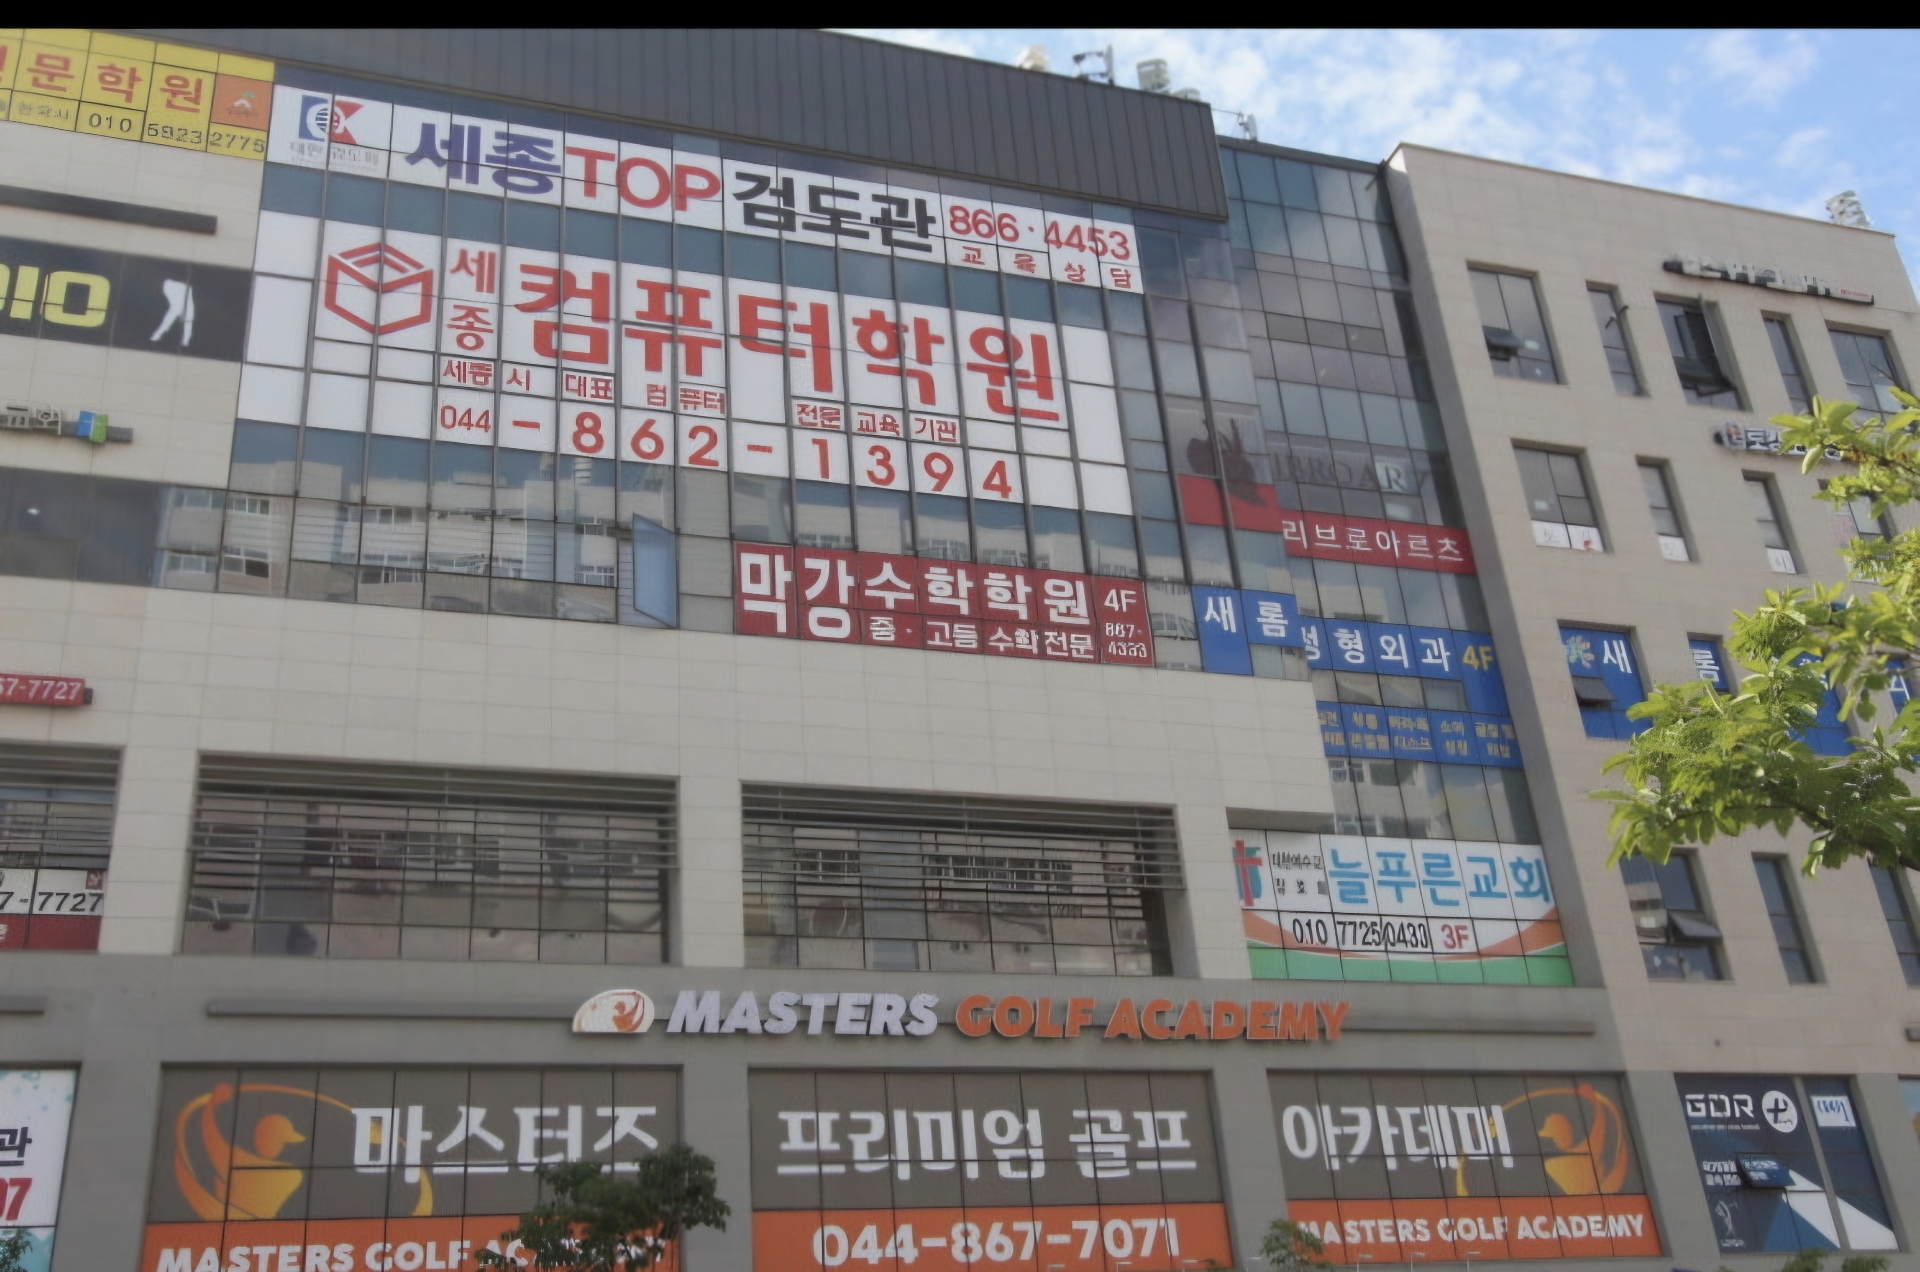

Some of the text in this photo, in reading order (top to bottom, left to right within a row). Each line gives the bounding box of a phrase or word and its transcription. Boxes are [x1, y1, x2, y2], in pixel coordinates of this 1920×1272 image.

[0, 45, 204, 113] 문학원
[88, 113, 132, 132] 010
[1282, 520, 1463, 562] 리브로아르츠
[1104, 588, 1137, 612] 4F
[1463, 645, 1494, 670] 4F
[1328, 848, 1554, 908] 늘푸른교회
[1441, 923, 1469, 949] 3F
[666, 990, 1351, 1040] MASTERS GOLF ACADEMY
[352, 1105, 658, 1184] 마스터즈
[777, 1109, 1197, 1180] 프리미엄 골프
[1282, 1104, 1514, 1171] 아카데미
[812, 1217, 1180, 1267] 044-867-7071
[1437, 1216, 1508, 1242] GOLF
[1517, 1214, 1643, 1240] ACADEMY
[156, 1243, 355, 1272] MASTERS
[364, 1240, 470, 1272] GOLF
